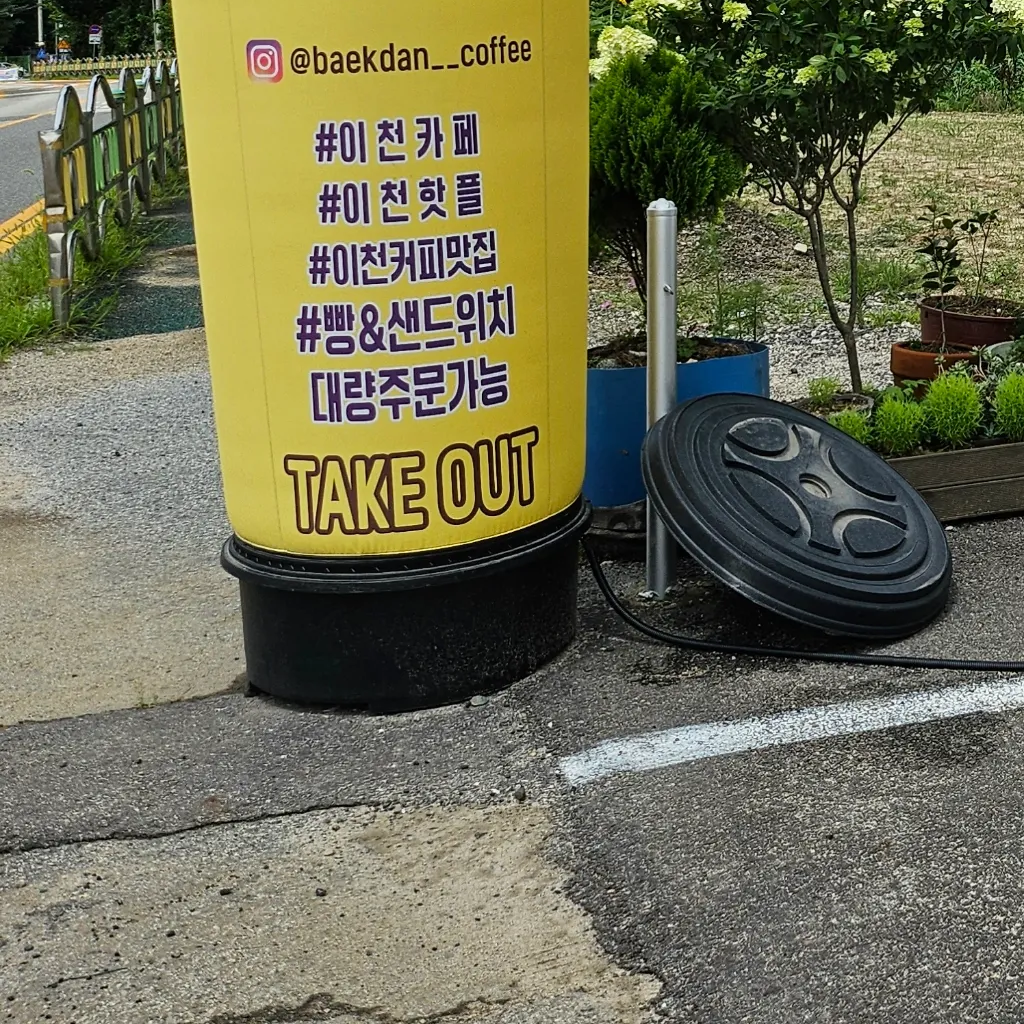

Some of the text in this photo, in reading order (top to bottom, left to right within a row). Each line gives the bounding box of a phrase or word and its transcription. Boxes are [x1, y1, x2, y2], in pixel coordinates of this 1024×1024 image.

[290, 35, 532, 75] @baekdan__coffee
[308, 229, 497, 286] #이천커피맛집
[295, 284, 516, 356] #빵&샌드위치
[310, 356, 509, 423] 대량주문가능
[284, 425, 539, 535] TAKE OUT
